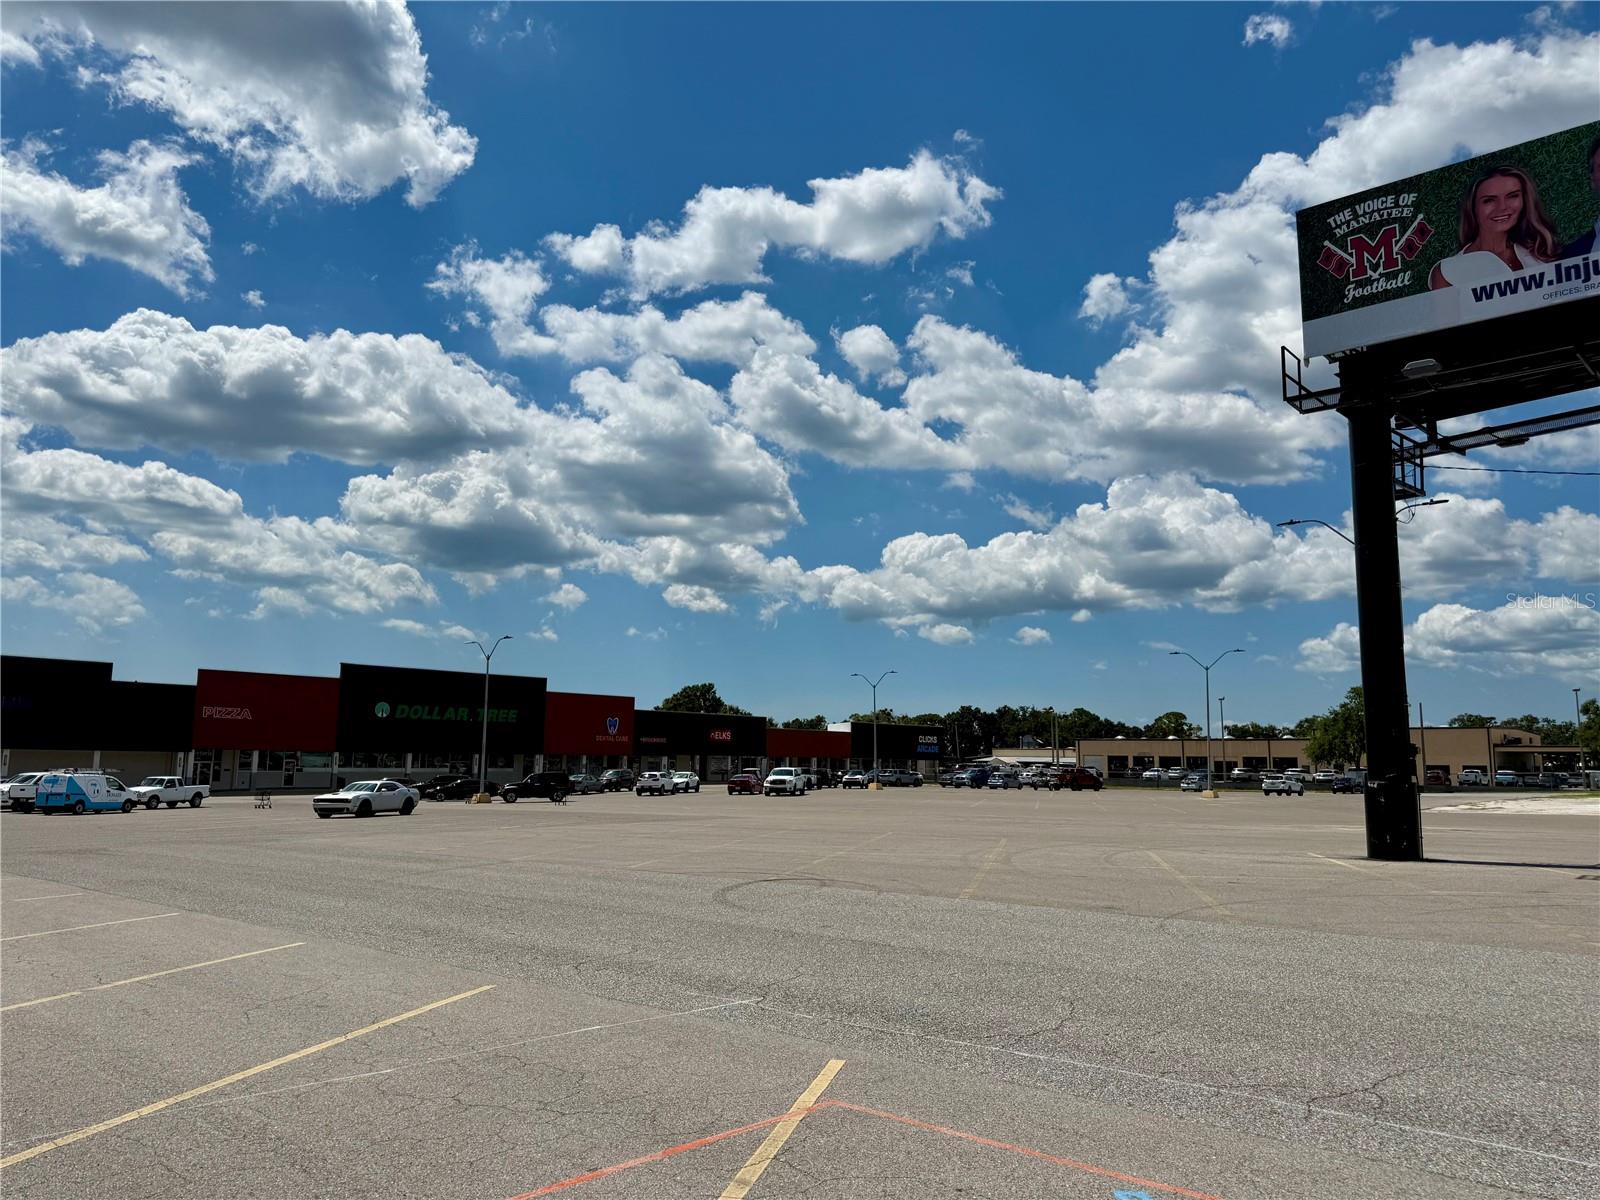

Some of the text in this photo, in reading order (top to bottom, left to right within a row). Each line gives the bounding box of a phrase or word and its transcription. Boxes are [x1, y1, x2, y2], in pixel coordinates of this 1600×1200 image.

[1327, 193, 1418, 228] THE VOICE OF
[1333, 207, 1414, 238] MANATEE
[1347, 223, 1402, 282] M
[1344, 270, 1412, 303] Football
[1543, 286, 1582, 300] OFFICES:
[203, 706, 252, 720] PIZZA
[395, 704, 520, 723] DOLLAR TREE
[918, 735, 938, 744] CLICKS
